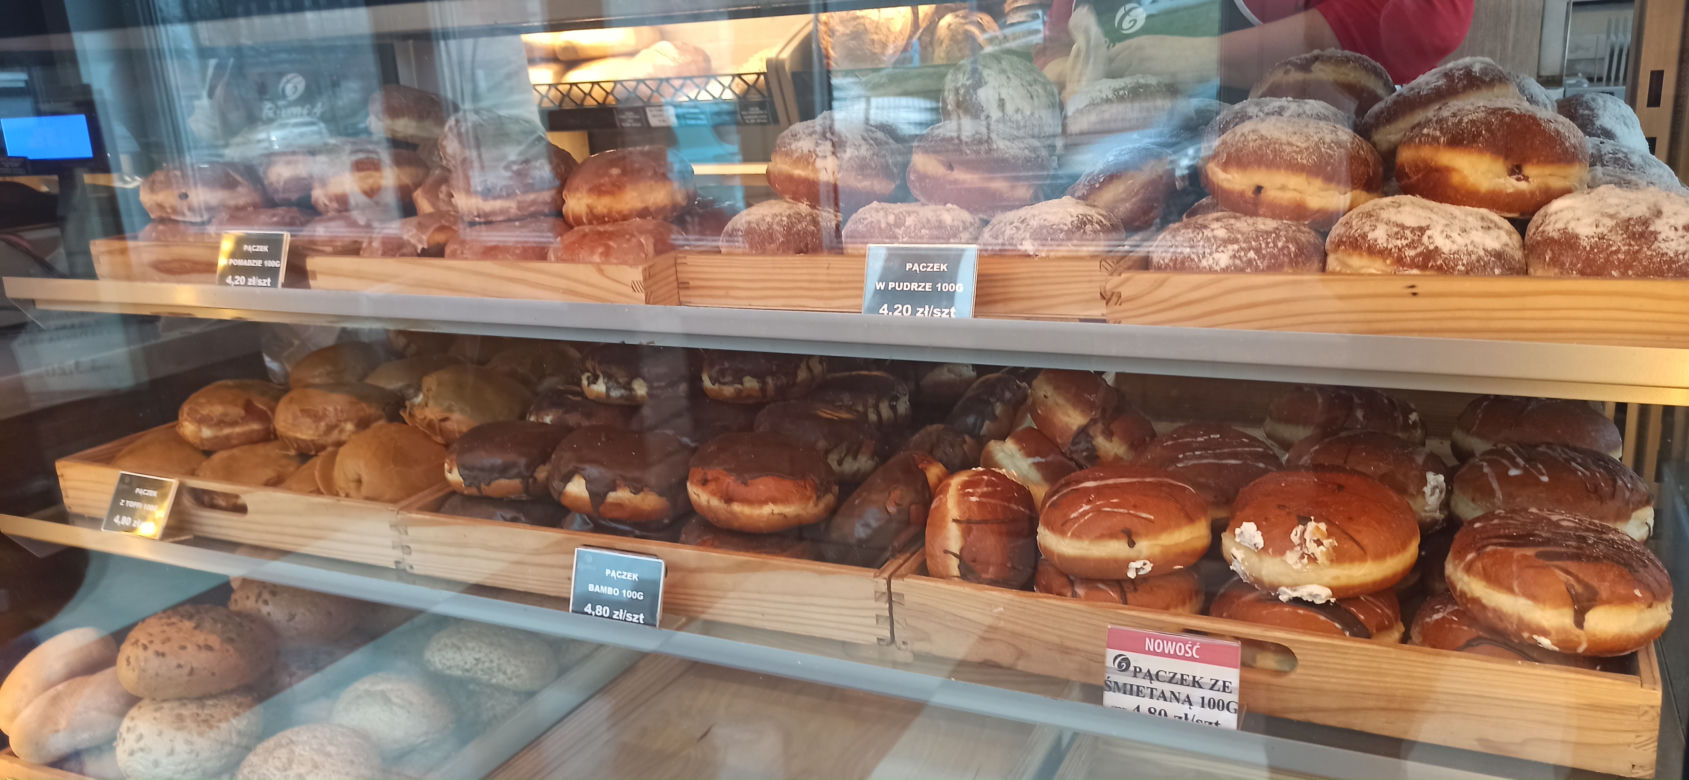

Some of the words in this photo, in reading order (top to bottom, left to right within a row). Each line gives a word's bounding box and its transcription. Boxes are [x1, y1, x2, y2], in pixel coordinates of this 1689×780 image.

[905, 263, 948, 273] PĄCZEK
[875, 281, 885, 290] W
[888, 282, 933, 291] PUDRZE
[936, 283, 964, 292] 100G
[916, 305, 957, 318] zł/szt
[605, 568, 639, 581] PĄCZEK
[588, 584, 619, 596] BAMBO
[622, 589, 644, 600] 100G
[584, 603, 610, 617] 4,80
[612, 608, 645, 624] zł/szt
[1145, 637, 1200, 659] NOWOŚĆ
[1132, 666, 1204, 690] PĄCZEK
[1210, 678, 1233, 694] ZE
[1104, 676, 1194, 709] ŚMIETANĄ
[1200, 696, 1239, 714] 100G
